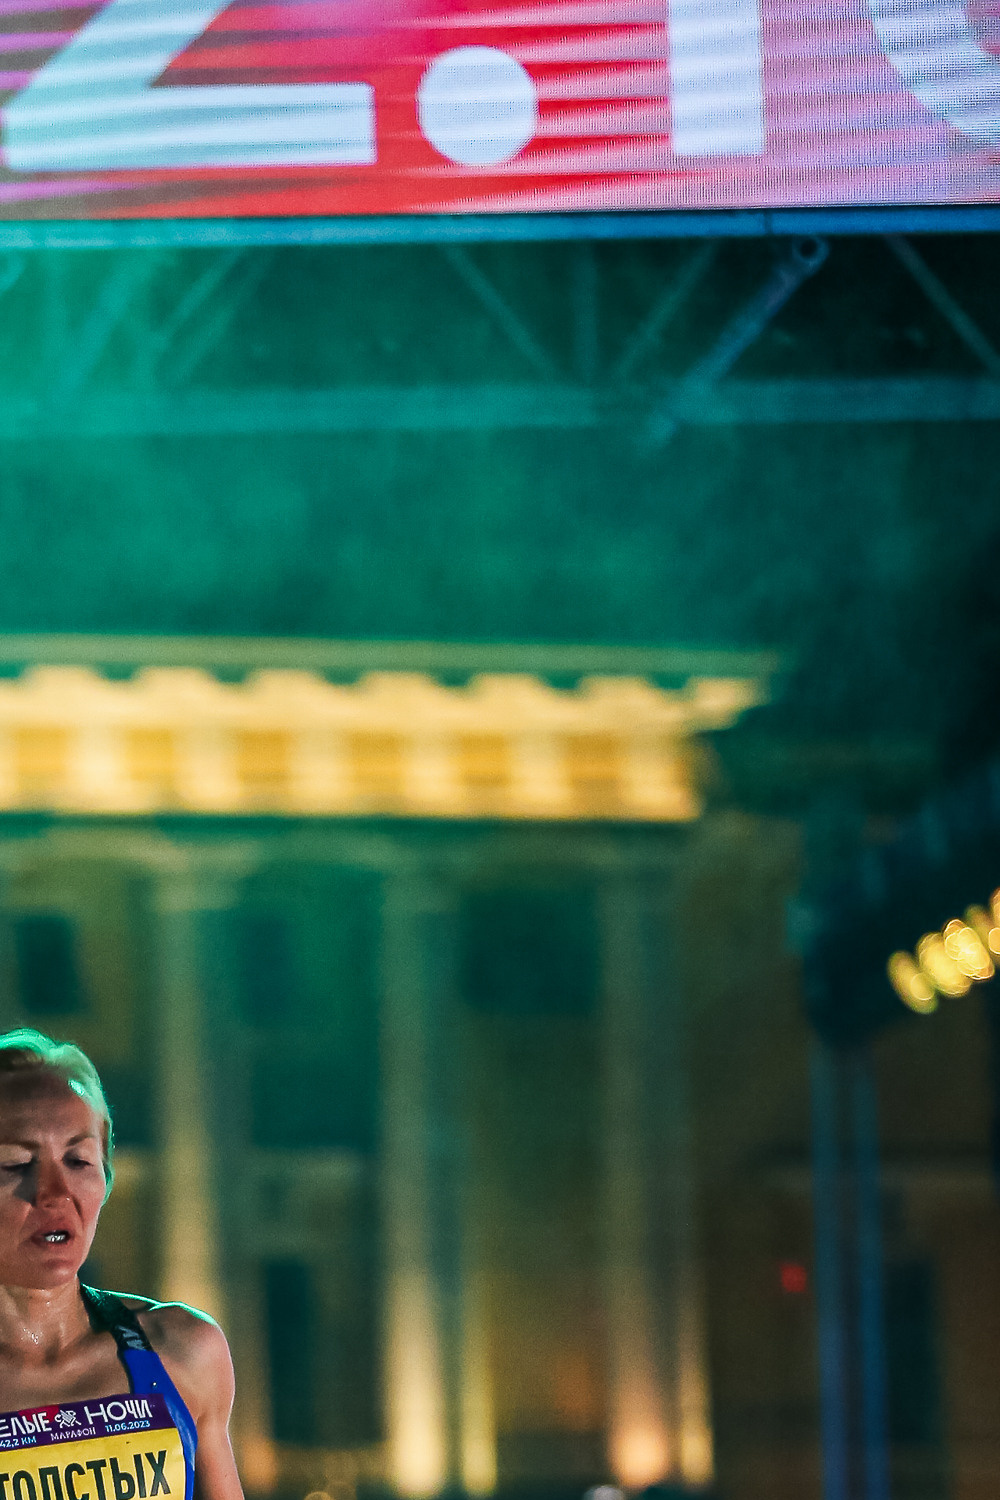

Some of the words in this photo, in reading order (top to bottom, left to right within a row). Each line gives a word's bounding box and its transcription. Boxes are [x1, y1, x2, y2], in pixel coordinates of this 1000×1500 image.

[83, 1399, 153, 1425] НОЧИ
[0, 1438, 20, 1448] 42,2
[21, 1435, 37, 1446] КМ
[50, 1427, 96, 1441] МАРАФОН
[104, 1420, 151, 1433] 11.06.2023
